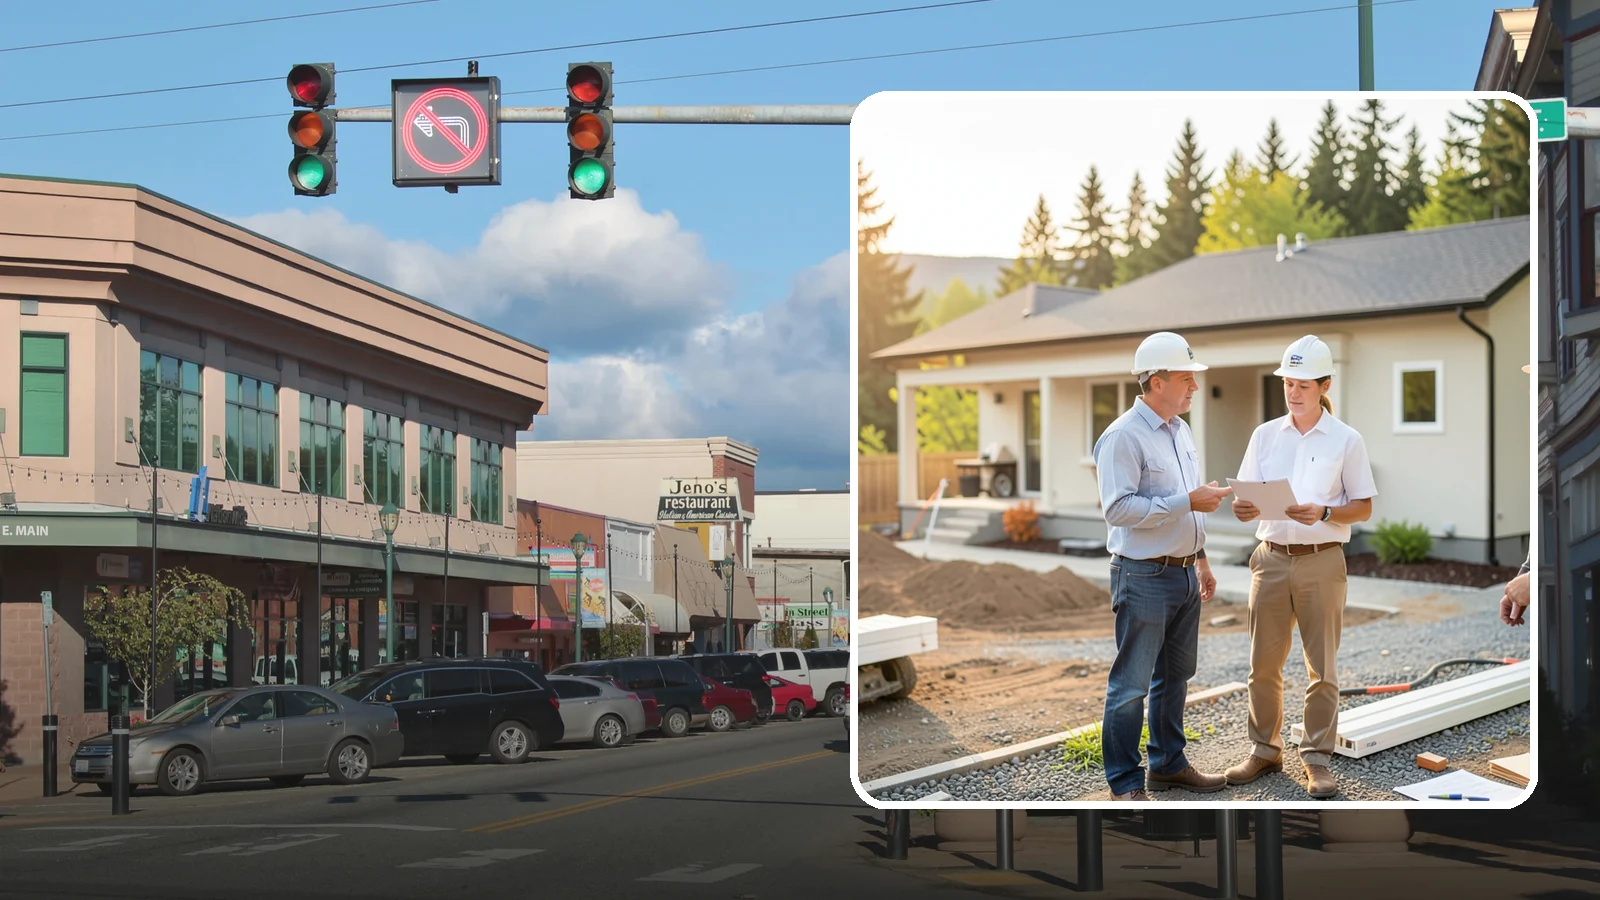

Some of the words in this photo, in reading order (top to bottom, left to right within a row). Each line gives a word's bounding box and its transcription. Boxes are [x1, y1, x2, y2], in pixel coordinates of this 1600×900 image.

[669, 480, 727, 495] Jeno's
[665, 496, 731, 509] restaurant
[659, 509, 681, 519] Italian
[686, 509, 714, 519] American
[715, 509, 738, 519] Cuisine
[2, 525, 12, 536] E.
[15, 525, 49, 536] MAIN
[797, 608, 828, 616] Street
